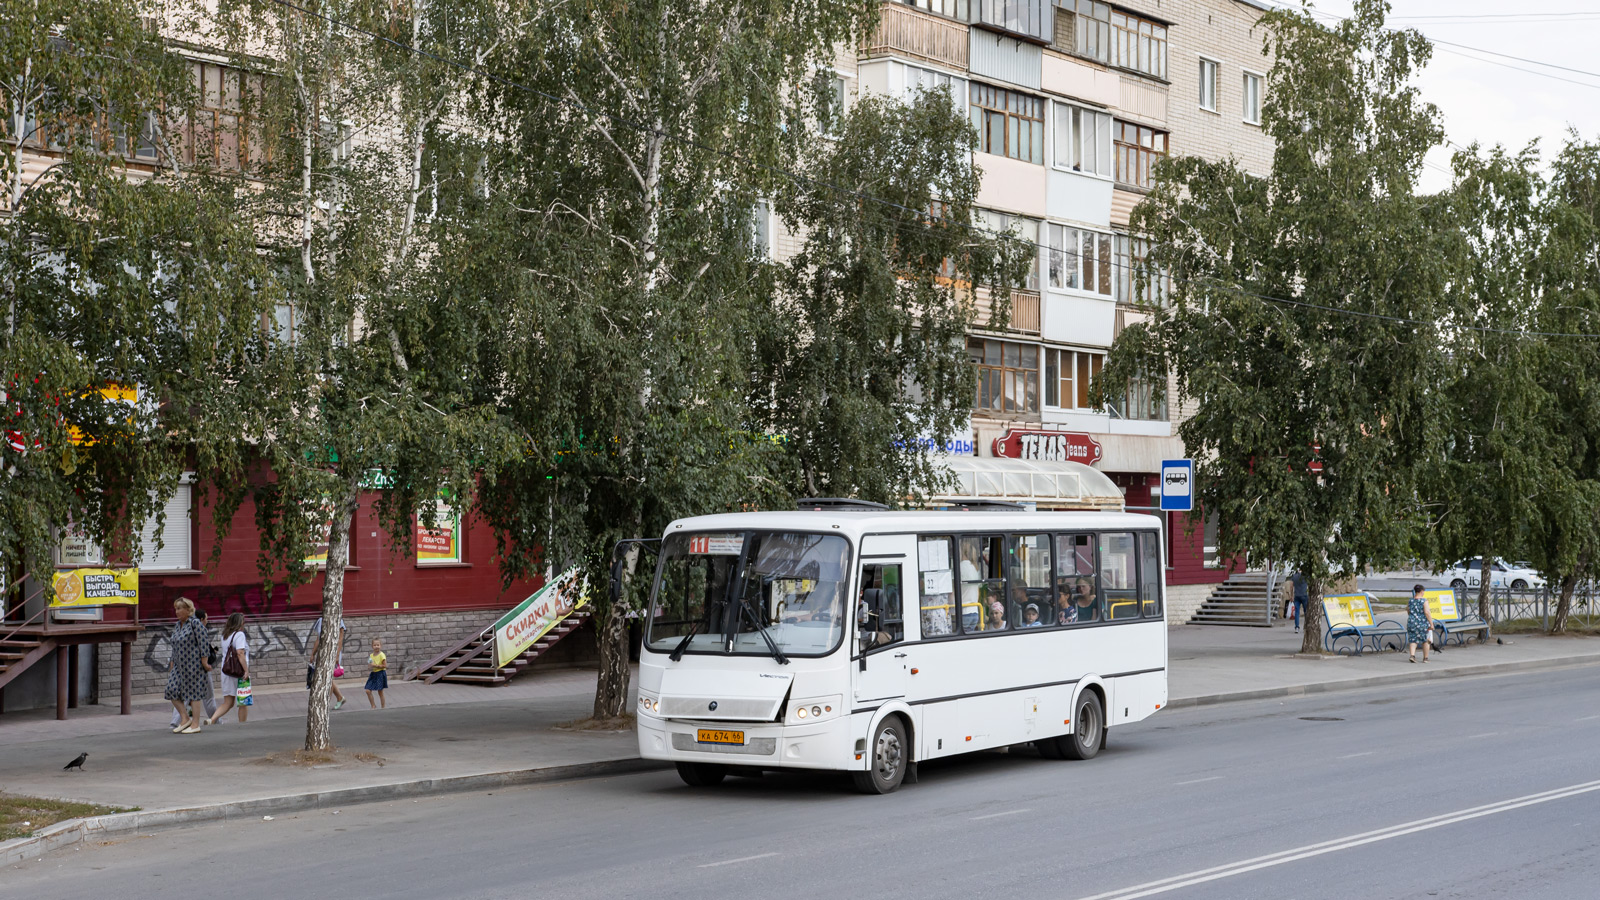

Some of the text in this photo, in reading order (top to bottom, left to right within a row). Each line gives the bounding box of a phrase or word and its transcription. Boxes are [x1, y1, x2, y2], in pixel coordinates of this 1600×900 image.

[1020, 432, 1088, 461] TEXAS jeans
[692, 537, 705, 553] 11
[714, 731, 729, 741] 674
